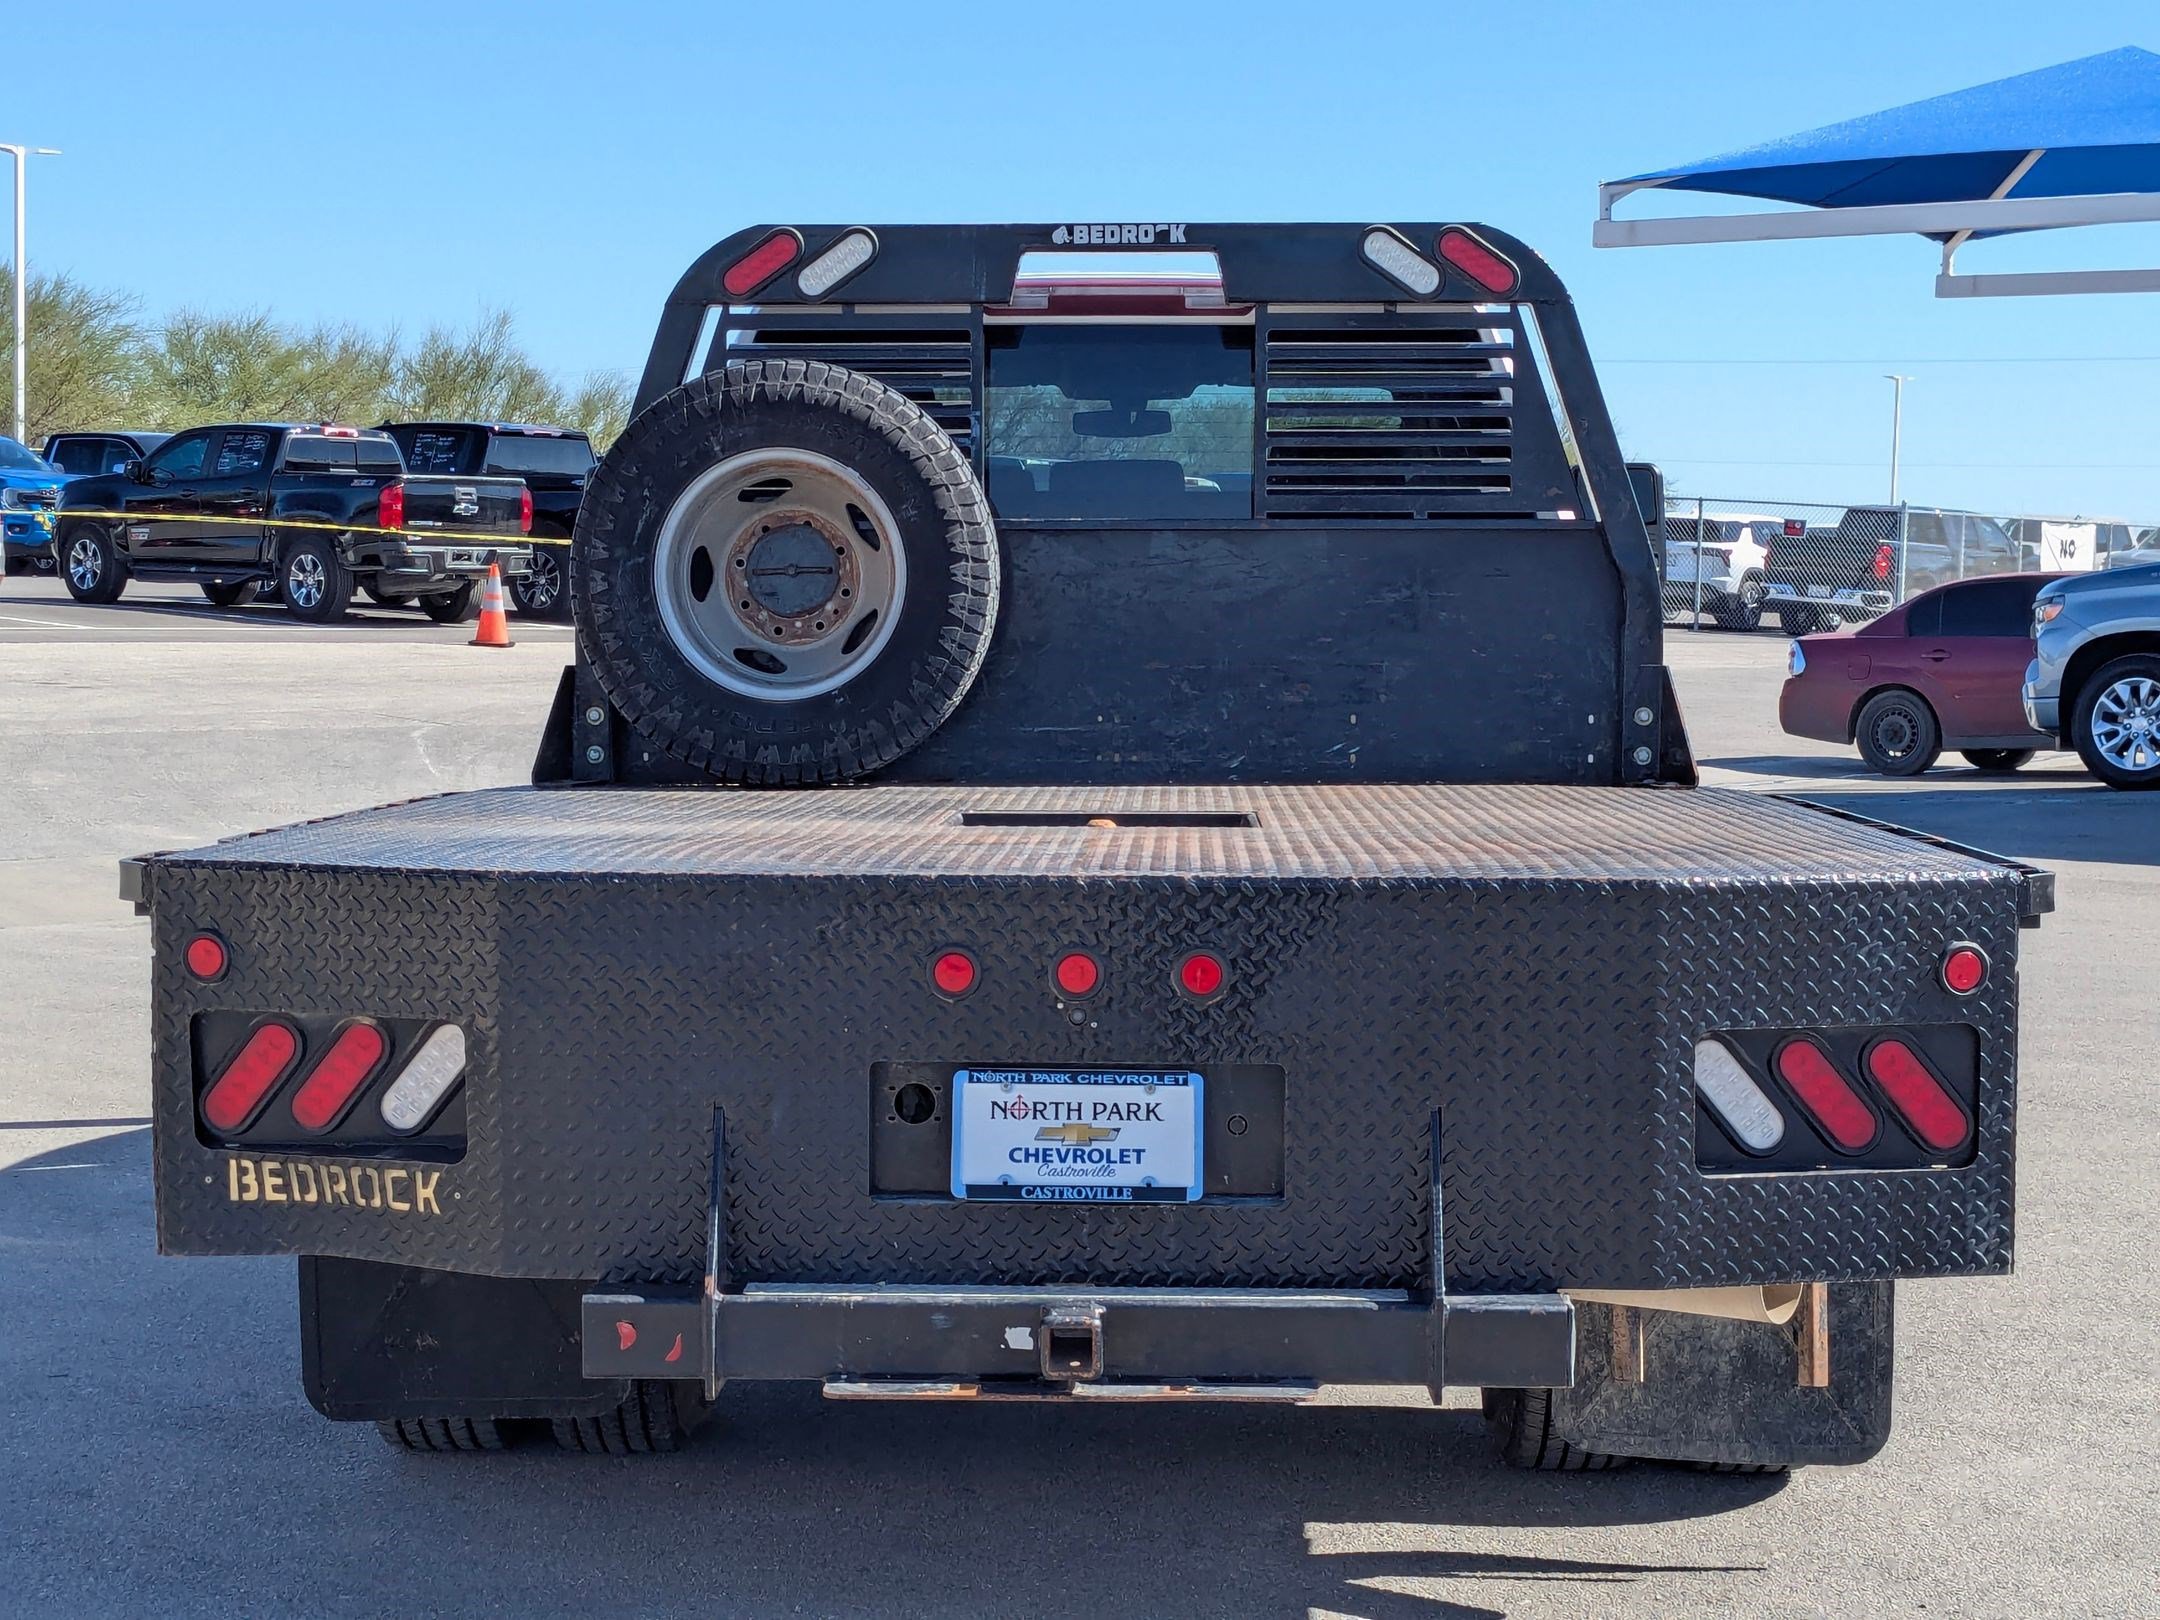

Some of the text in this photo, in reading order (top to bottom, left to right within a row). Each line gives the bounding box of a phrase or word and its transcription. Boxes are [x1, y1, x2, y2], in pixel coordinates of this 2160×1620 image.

[970, 1070, 1187, 1085] NORTH PARK CHEVROLET
[990, 1098, 1165, 1122] NORTH PARK
[1008, 1147, 1146, 1165] CHEVROLET
[1037, 1162, 1117, 1178] Castroville
[228, 1158, 441, 1215] BEDROCK
[1021, 1186, 1133, 1200] CASTROVILLE
